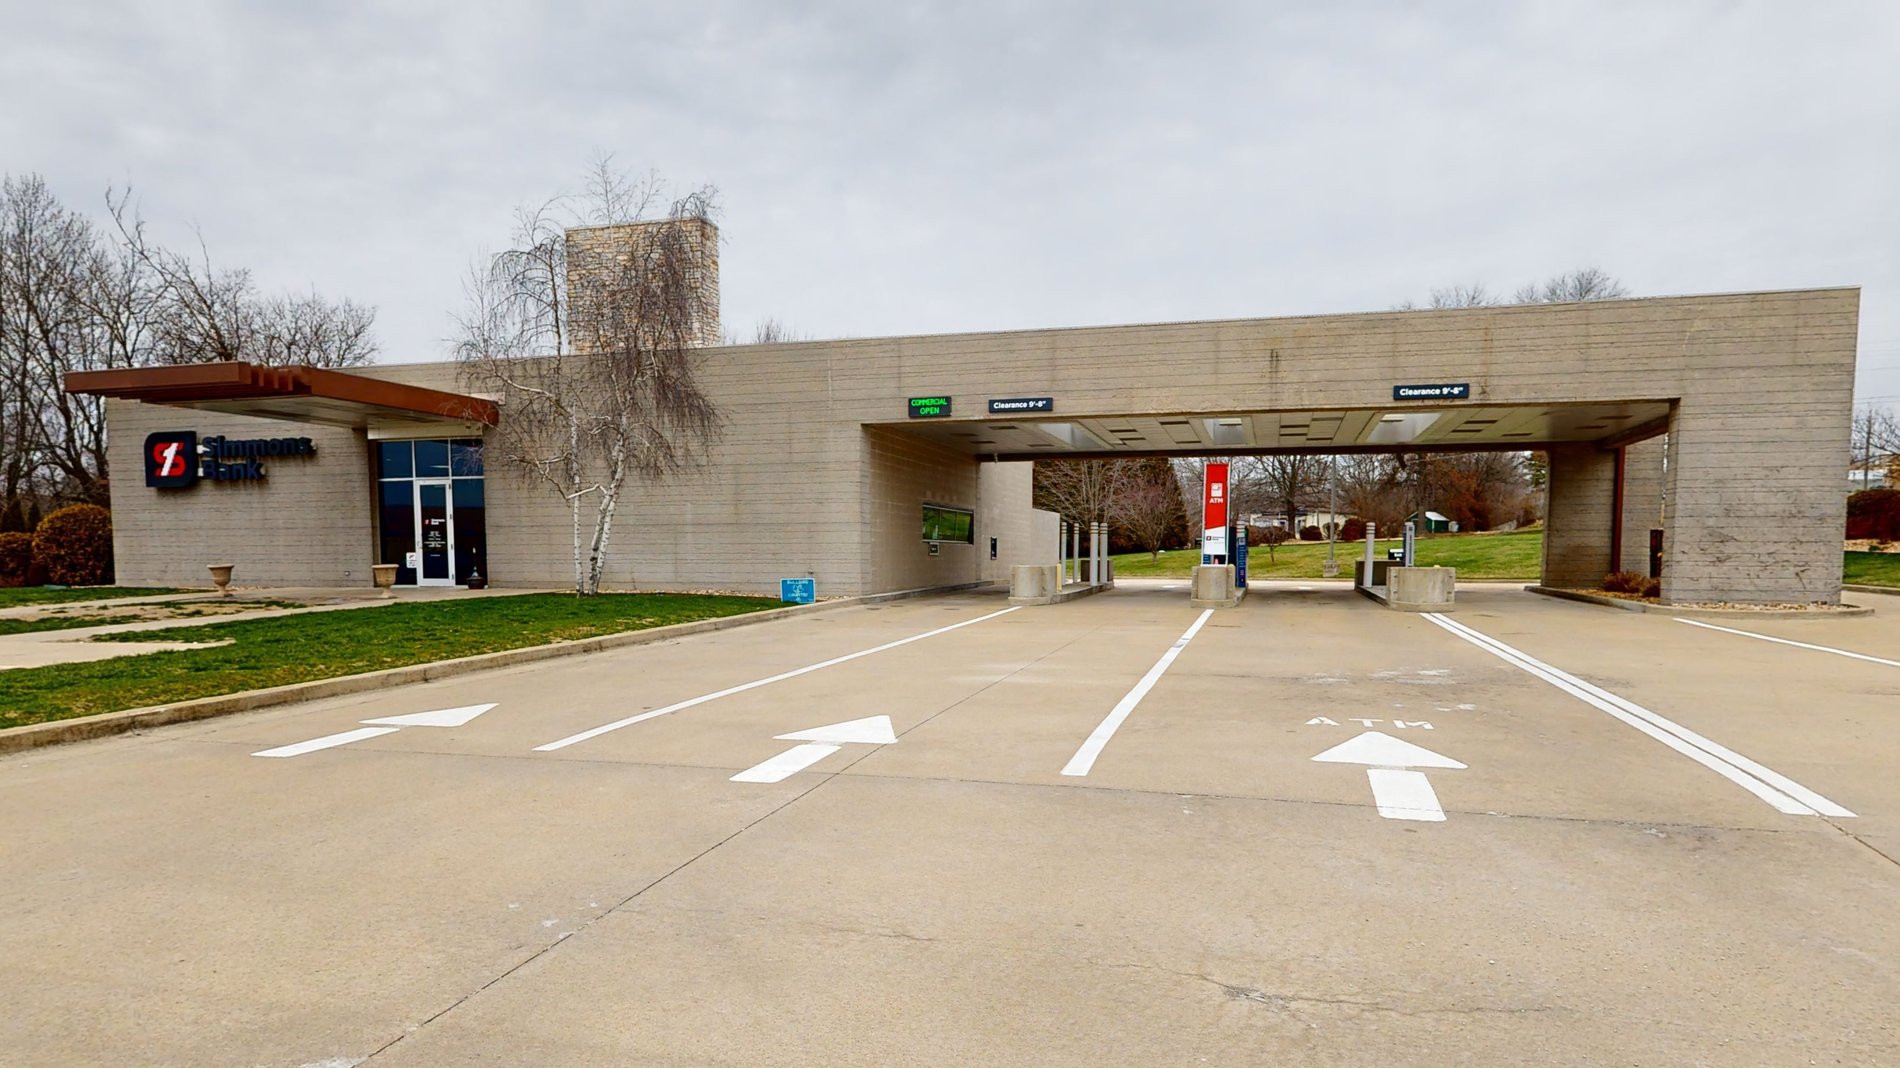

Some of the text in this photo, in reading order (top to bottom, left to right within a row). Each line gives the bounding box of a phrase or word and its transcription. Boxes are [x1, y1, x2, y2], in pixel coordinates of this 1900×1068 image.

[1399, 386, 1441, 396] Clearance
[910, 397, 948, 407] COMMERCIAL
[993, 401, 1028, 409] Clearance
[919, 407, 940, 415] OPEN
[201, 435, 314, 457] Simmons
[201, 457, 265, 481] Bank
[1304, 716, 1435, 730] ATM
